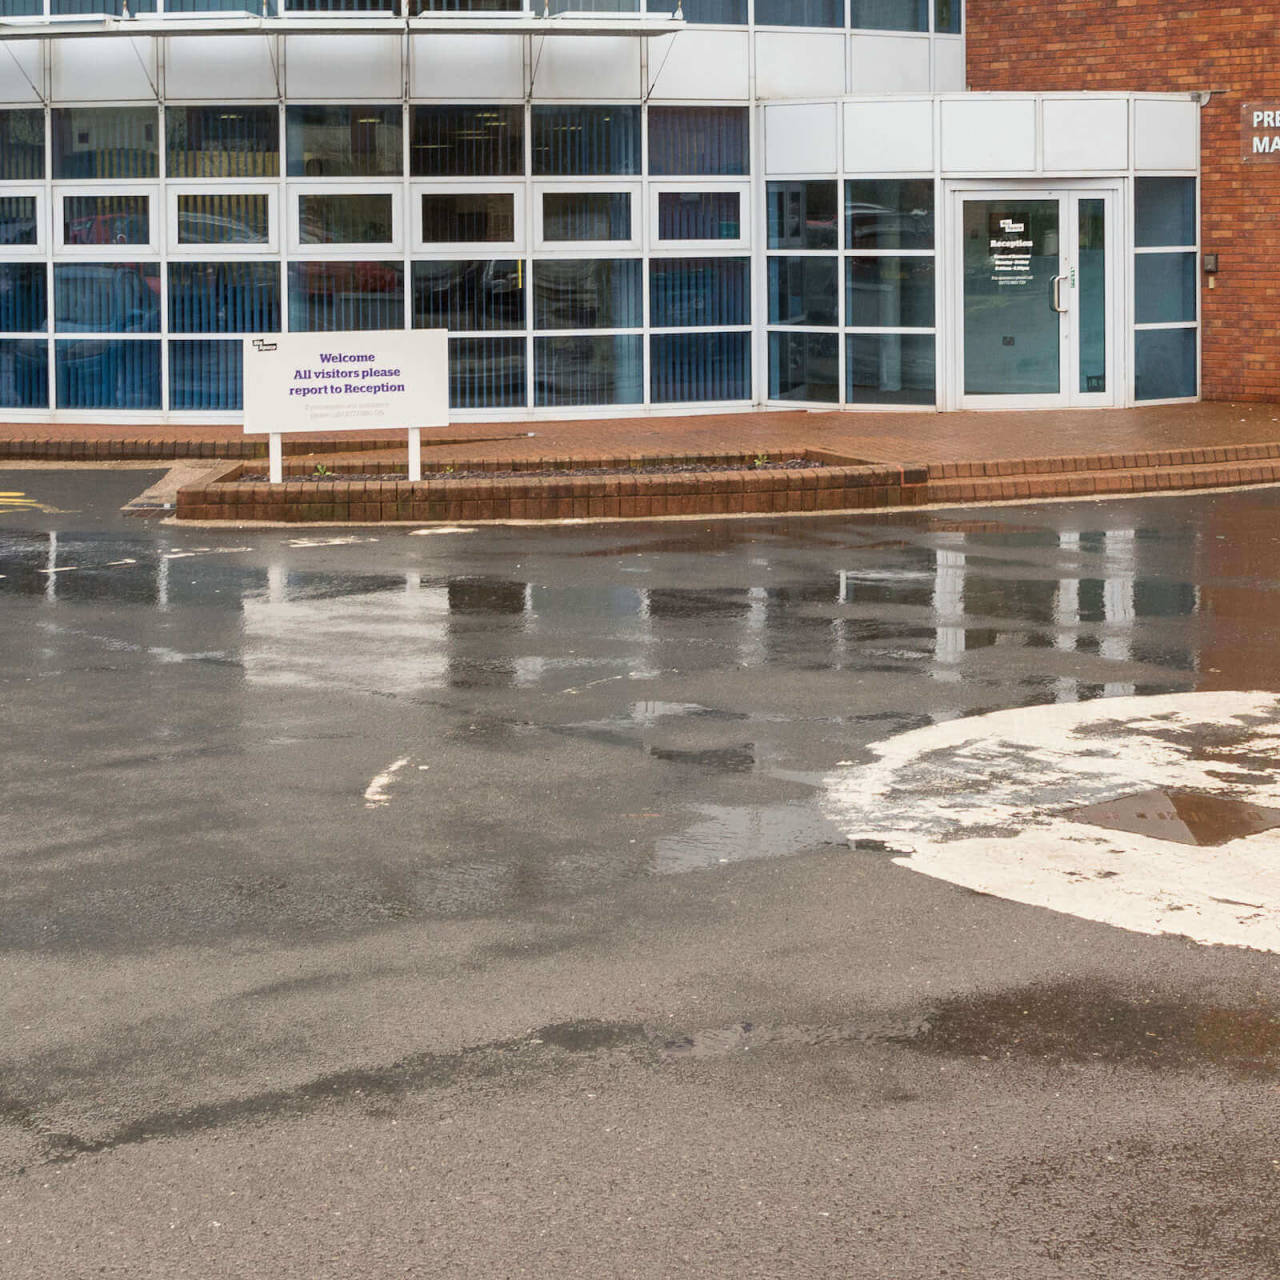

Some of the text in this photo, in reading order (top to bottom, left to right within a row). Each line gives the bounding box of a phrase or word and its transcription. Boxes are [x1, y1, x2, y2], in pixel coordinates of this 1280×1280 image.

[320, 353, 375, 364] Welcome
[294, 367, 401, 380] All visitors please
[289, 383, 405, 397] report to Reception
